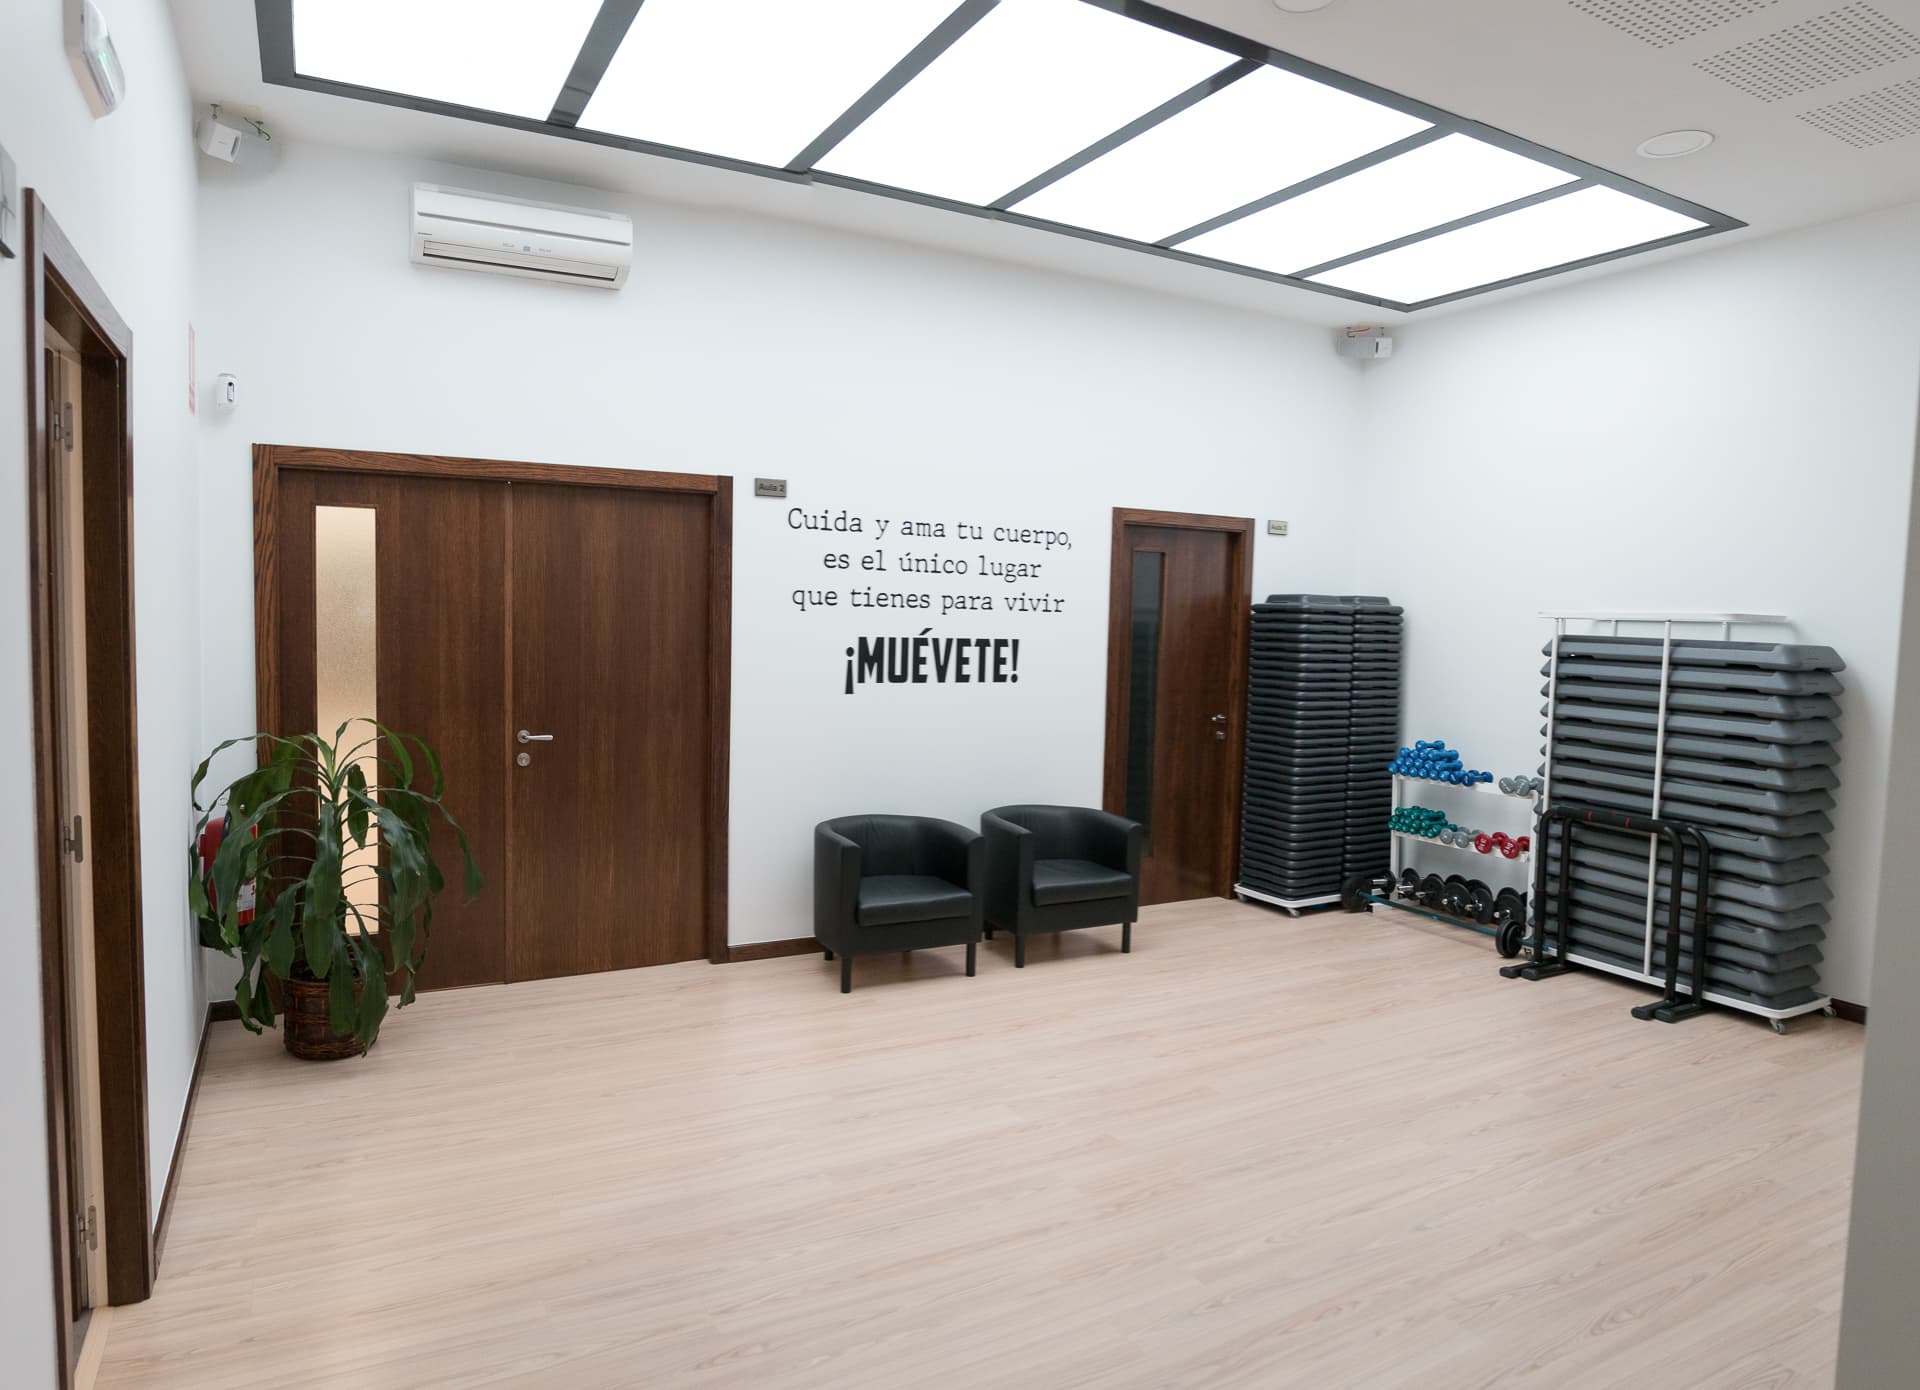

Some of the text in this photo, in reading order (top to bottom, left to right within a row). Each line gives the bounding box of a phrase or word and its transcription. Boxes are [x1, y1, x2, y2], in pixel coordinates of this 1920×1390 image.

[788, 508, 1073, 551] Cuida y ama tu cuerpo,
[823, 550, 1042, 583] es el único lugar
[792, 586, 1066, 615] que tienes para vivir
[844, 627, 1020, 695] ¡MUÉVETE!
